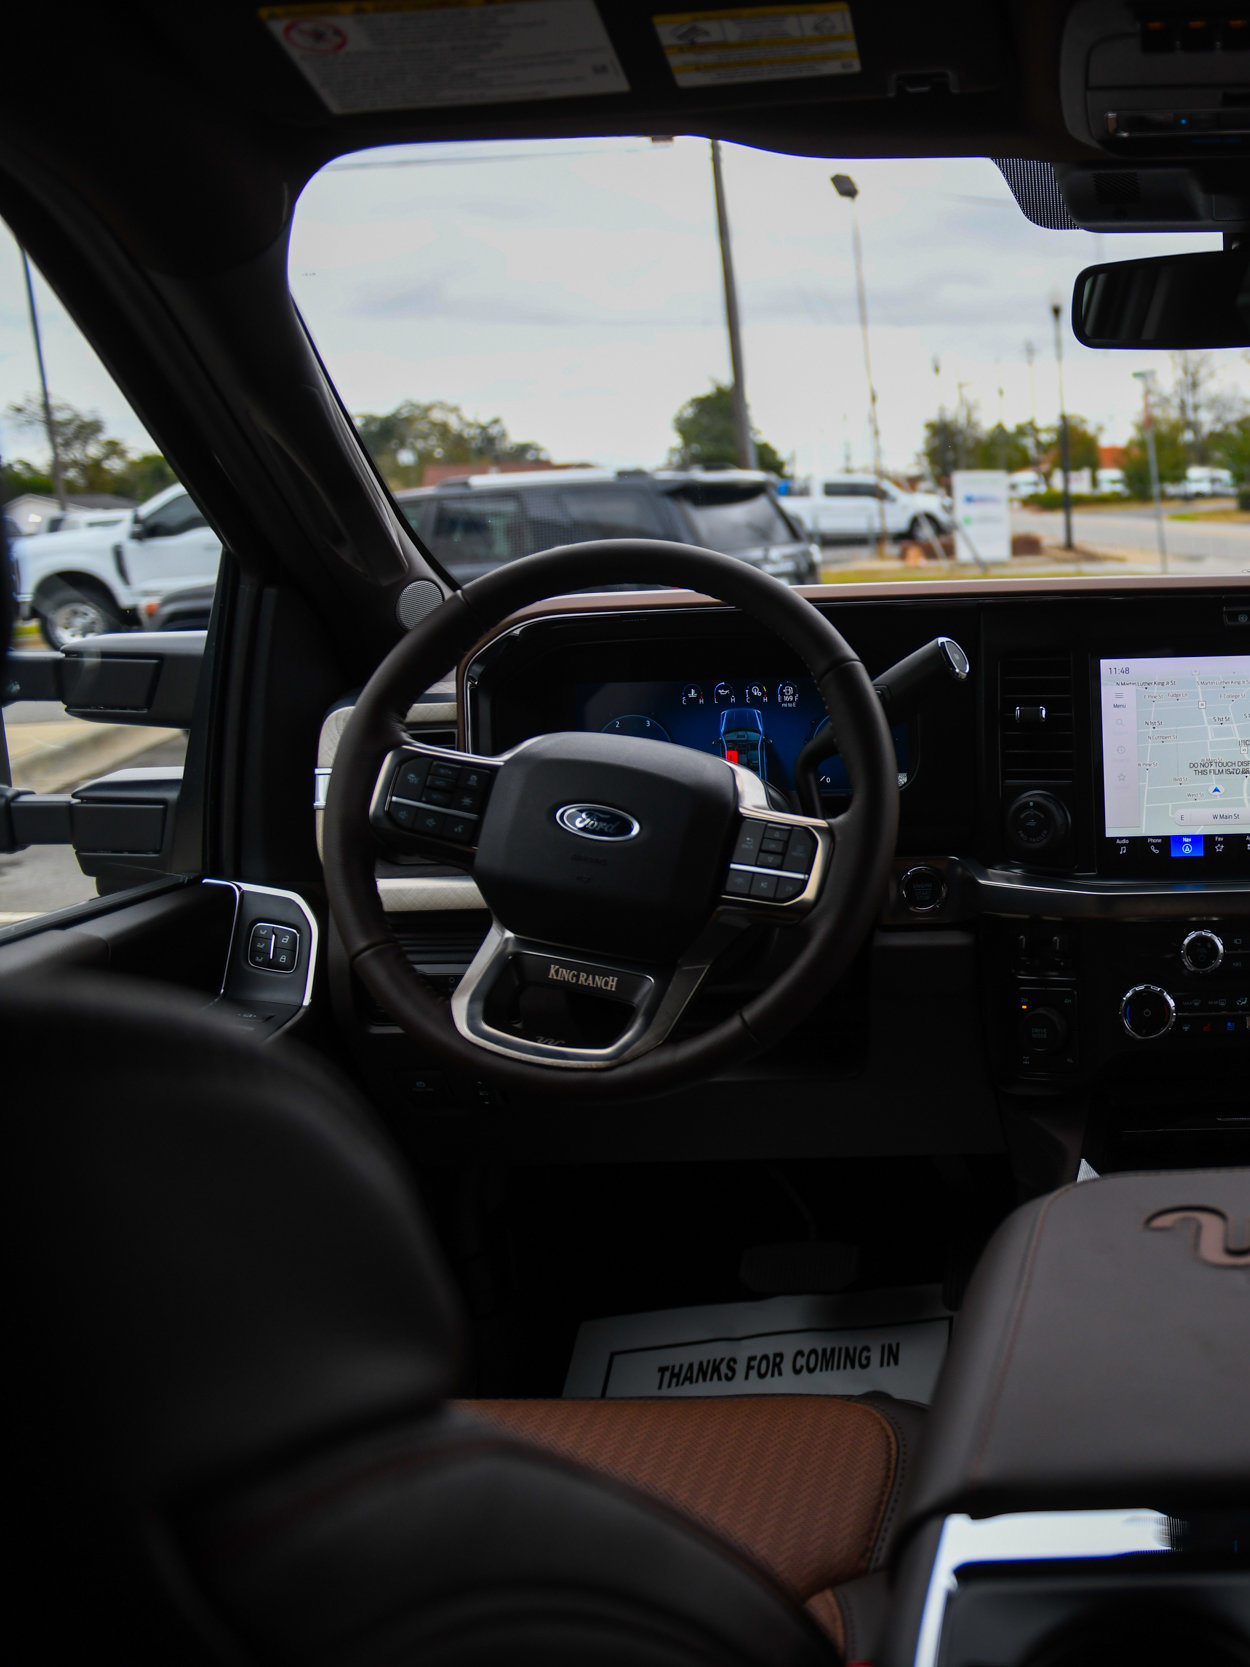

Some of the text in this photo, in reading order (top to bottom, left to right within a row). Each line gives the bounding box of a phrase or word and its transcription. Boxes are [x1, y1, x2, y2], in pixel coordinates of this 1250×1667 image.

[1108, 666, 1130, 675] 11:48
[575, 810, 619, 834] Ford
[1219, 812, 1231, 820] Main
[1232, 812, 1240, 820] St
[548, 964, 618, 991] KING RANCH
[656, 1341, 900, 1390] THANKS FOR COMING IN
